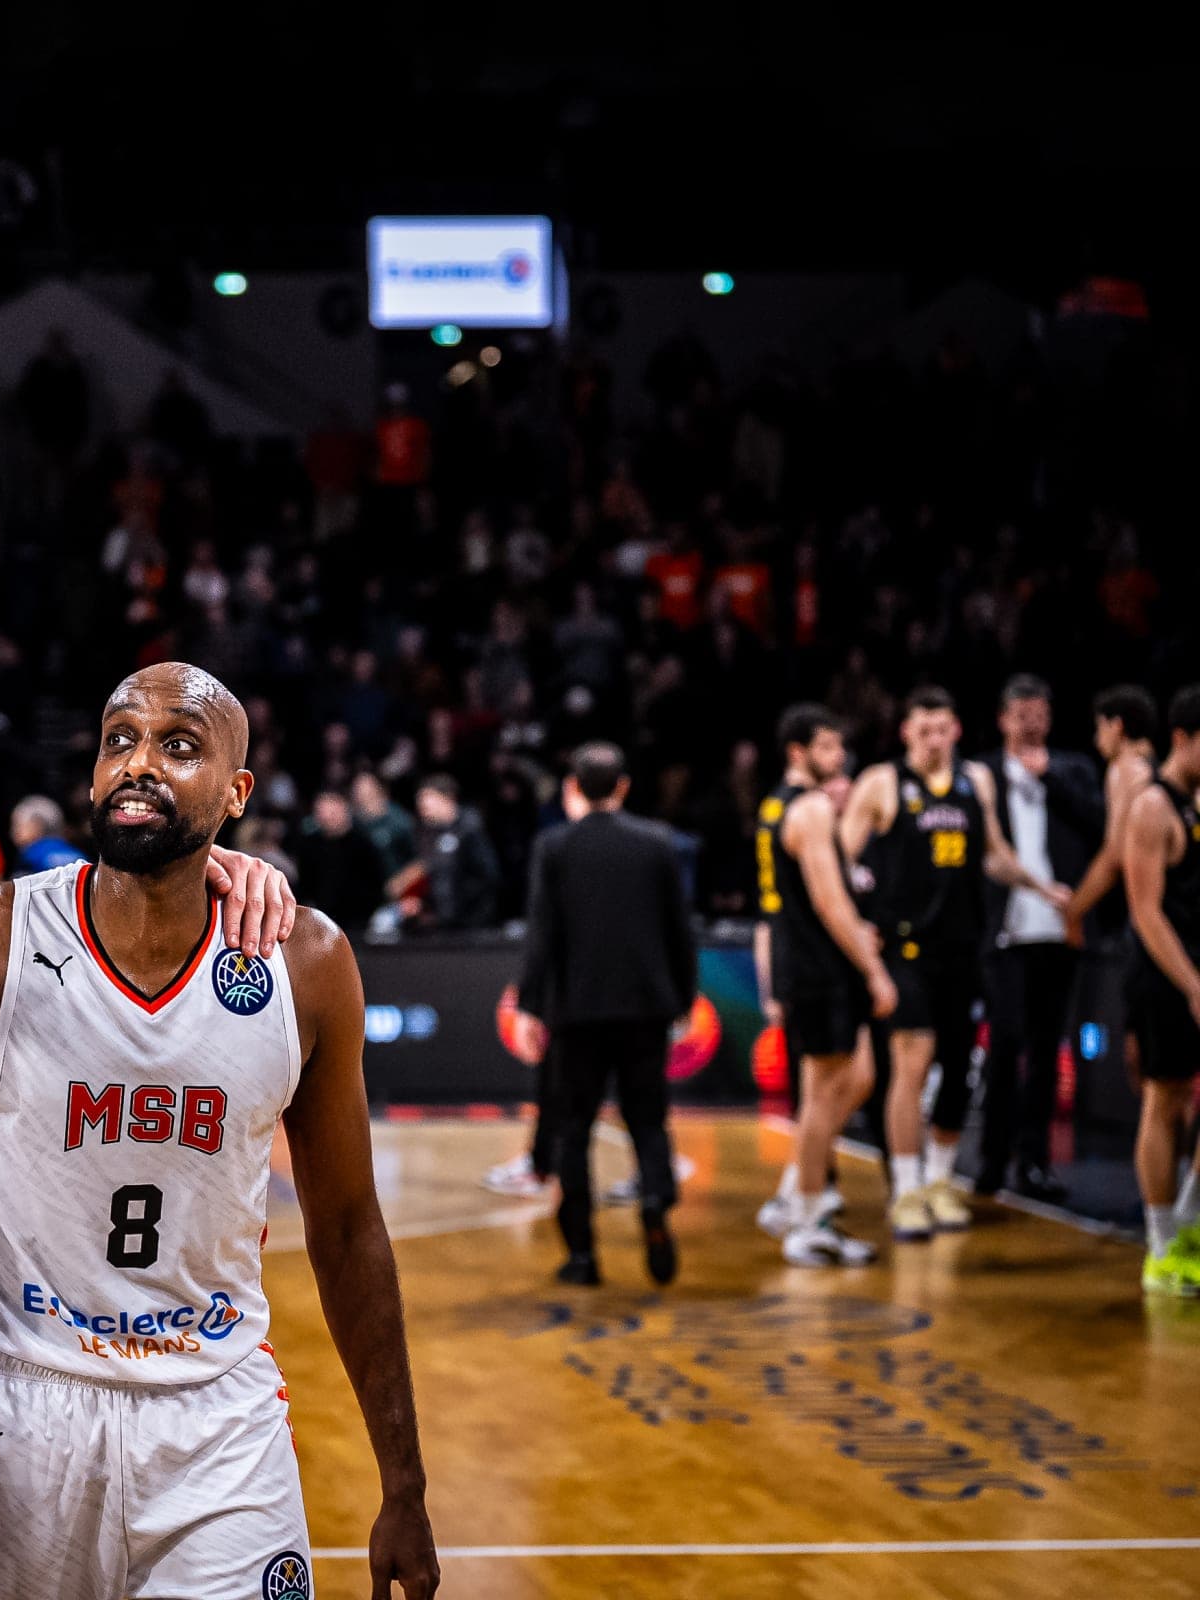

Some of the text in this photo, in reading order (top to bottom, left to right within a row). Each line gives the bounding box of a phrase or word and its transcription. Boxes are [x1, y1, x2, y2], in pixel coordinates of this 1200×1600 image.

[64, 1081, 227, 1155] MSB
[106, 1184, 163, 1269] 8
[78, 1331, 201, 1360] LE MANS
